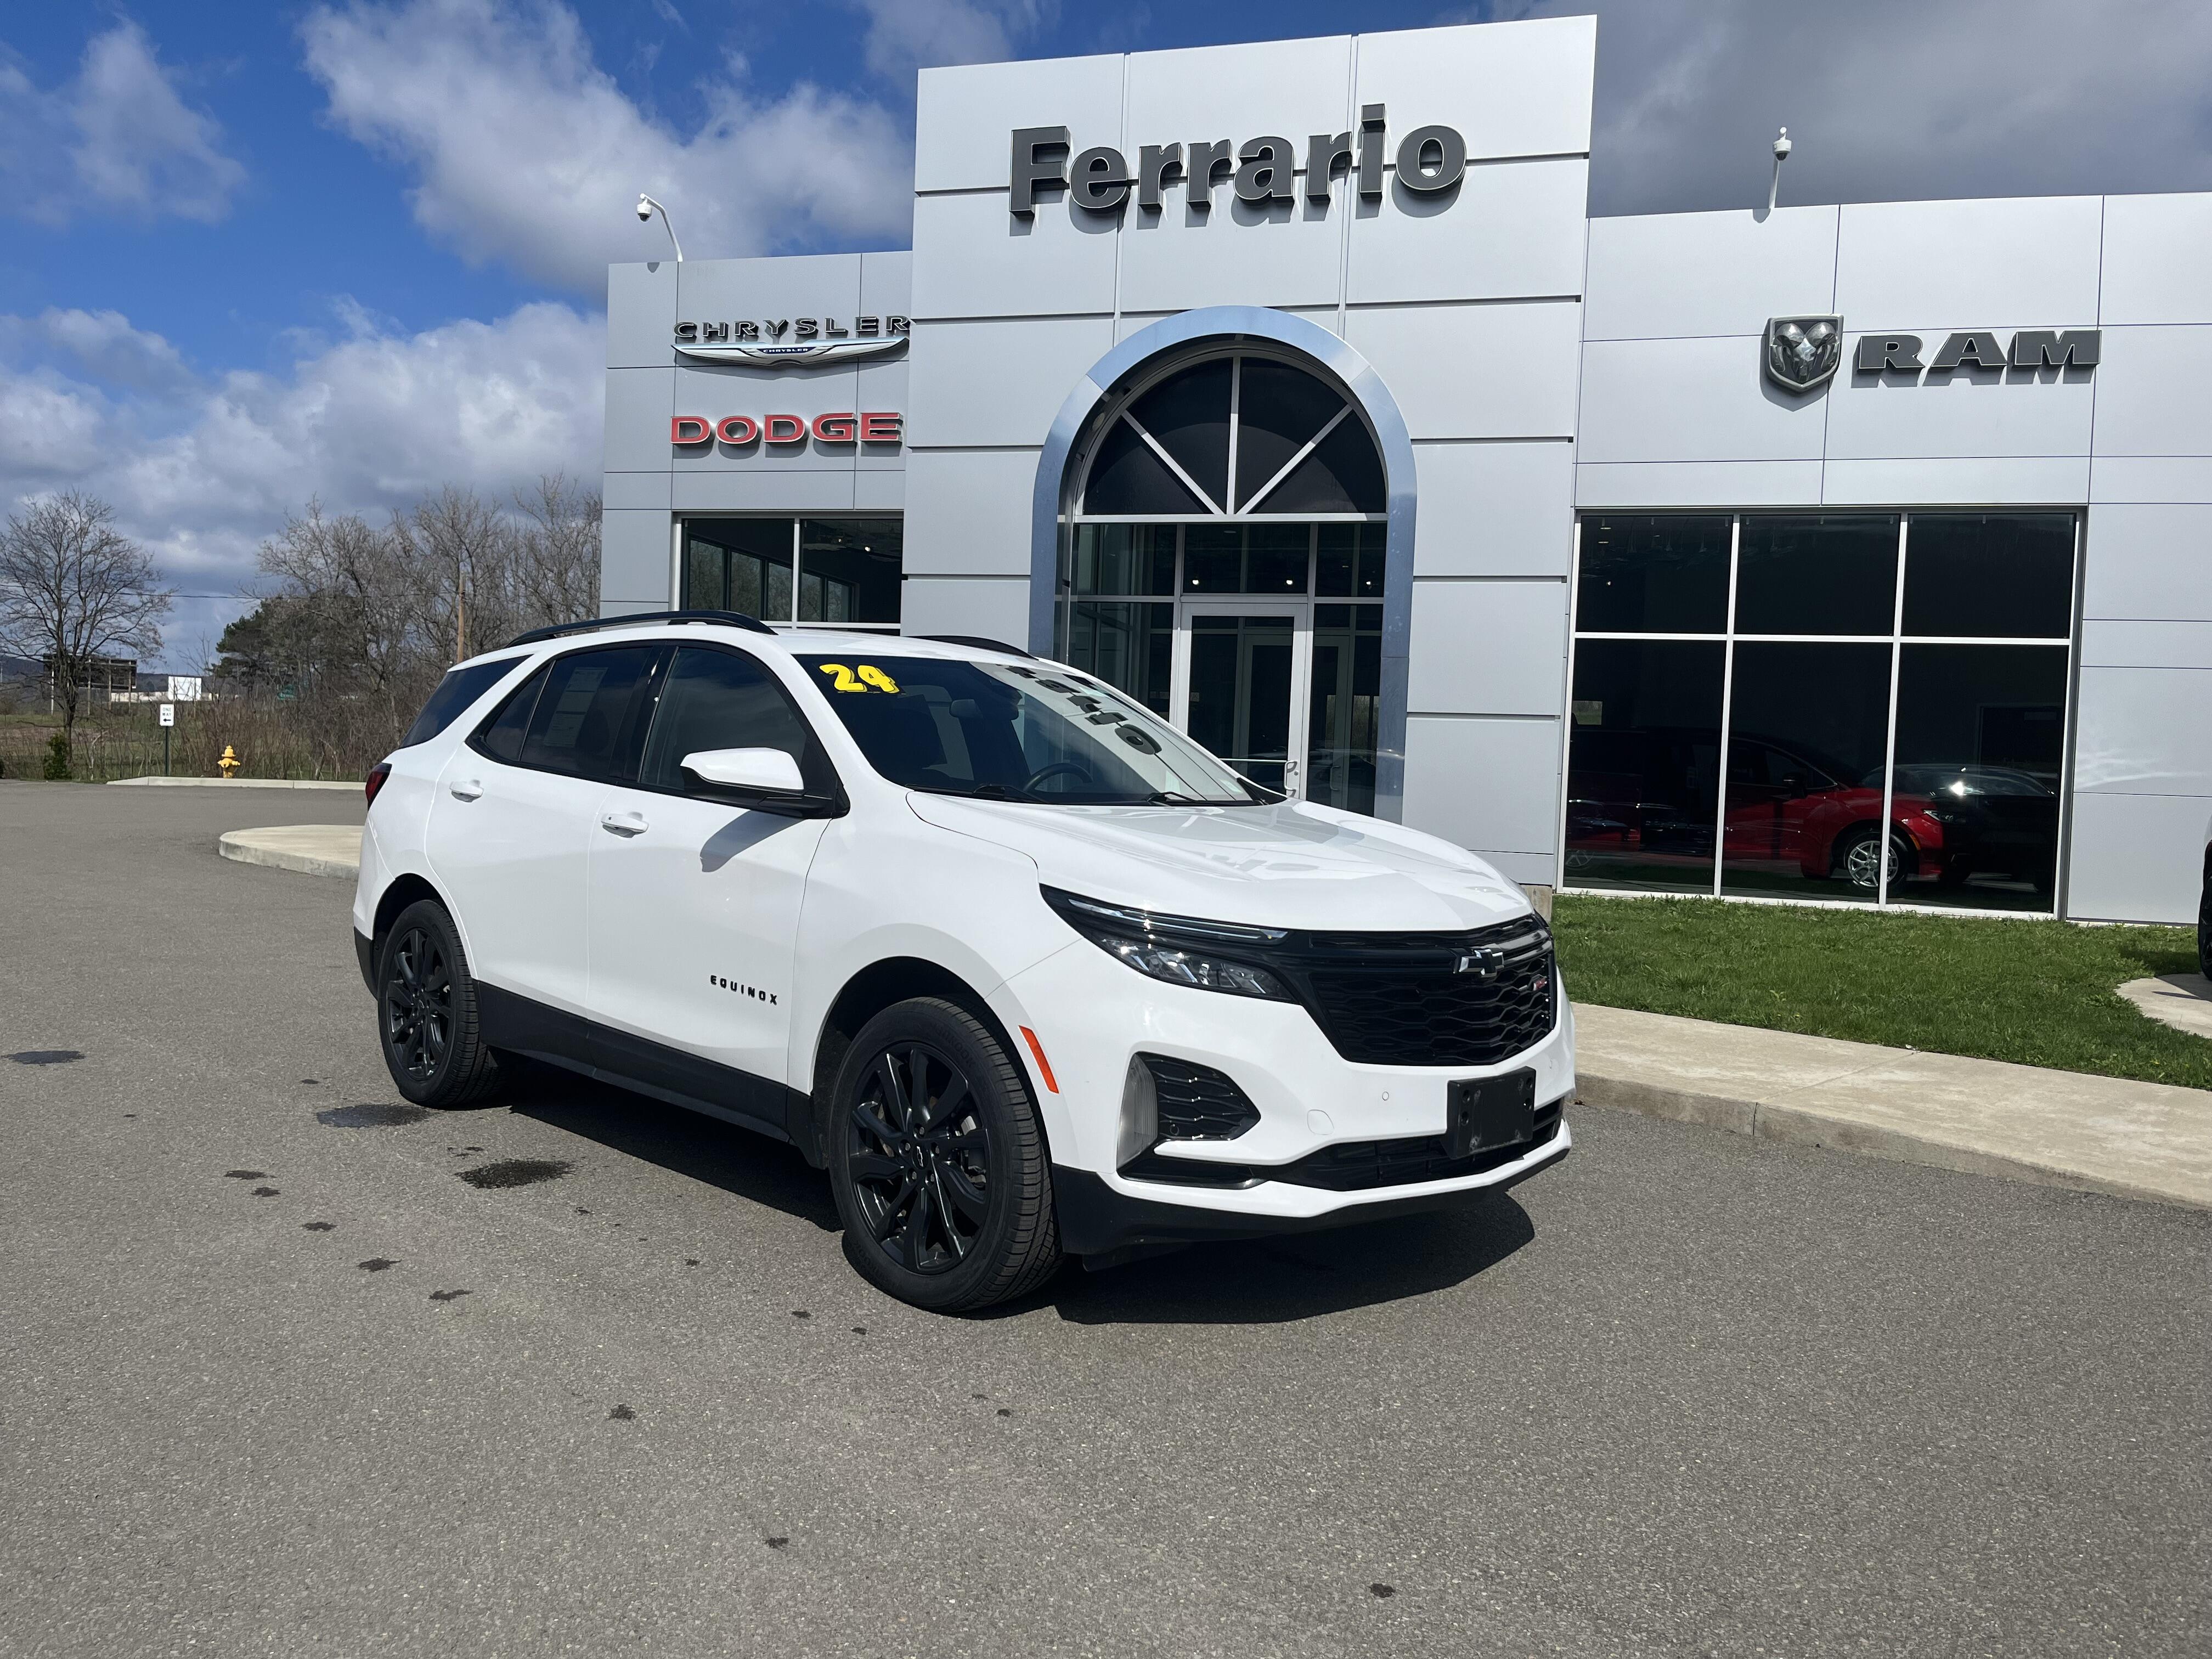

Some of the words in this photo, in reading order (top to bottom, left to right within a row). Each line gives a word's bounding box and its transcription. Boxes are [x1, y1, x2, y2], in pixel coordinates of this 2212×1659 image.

[1009, 103, 1467, 218] Ferrario
[673, 315, 911, 338] CHRYSLER
[1855, 330, 2102, 370] RAM
[670, 412, 903, 445] DODGE
[819, 663, 900, 694] 24
[710, 975, 777, 1006] EQUINOX
